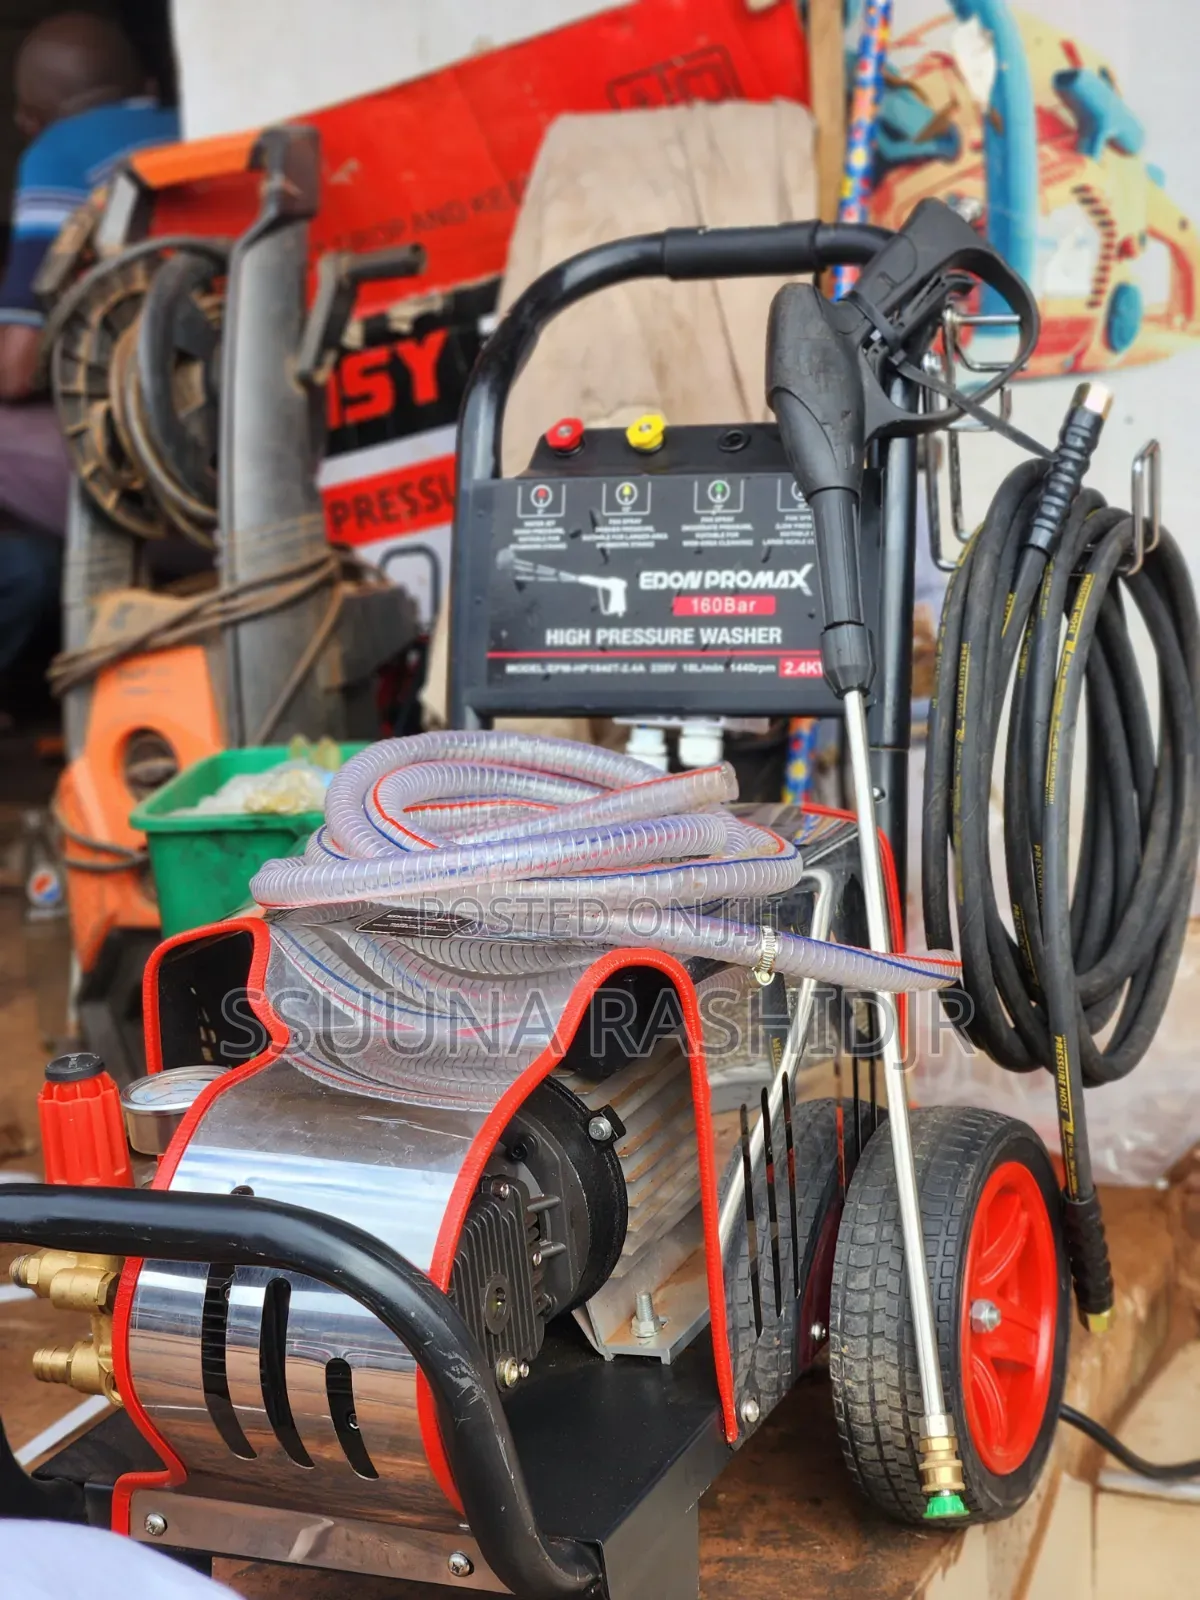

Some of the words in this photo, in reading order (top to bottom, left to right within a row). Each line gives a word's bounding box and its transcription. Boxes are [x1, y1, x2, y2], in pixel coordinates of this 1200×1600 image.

[639, 570, 703, 590] EDON
[704, 563, 814, 597] PROMAX
[691, 597, 757, 614] 160Bar
[545, 628, 591, 646] HIGH
[595, 627, 695, 645] PRESSURE
[699, 626, 783, 645] WASHER
[1054, 1035, 1068, 1087] PRESSURE
[1060, 1087, 1070, 1113] HOSE
